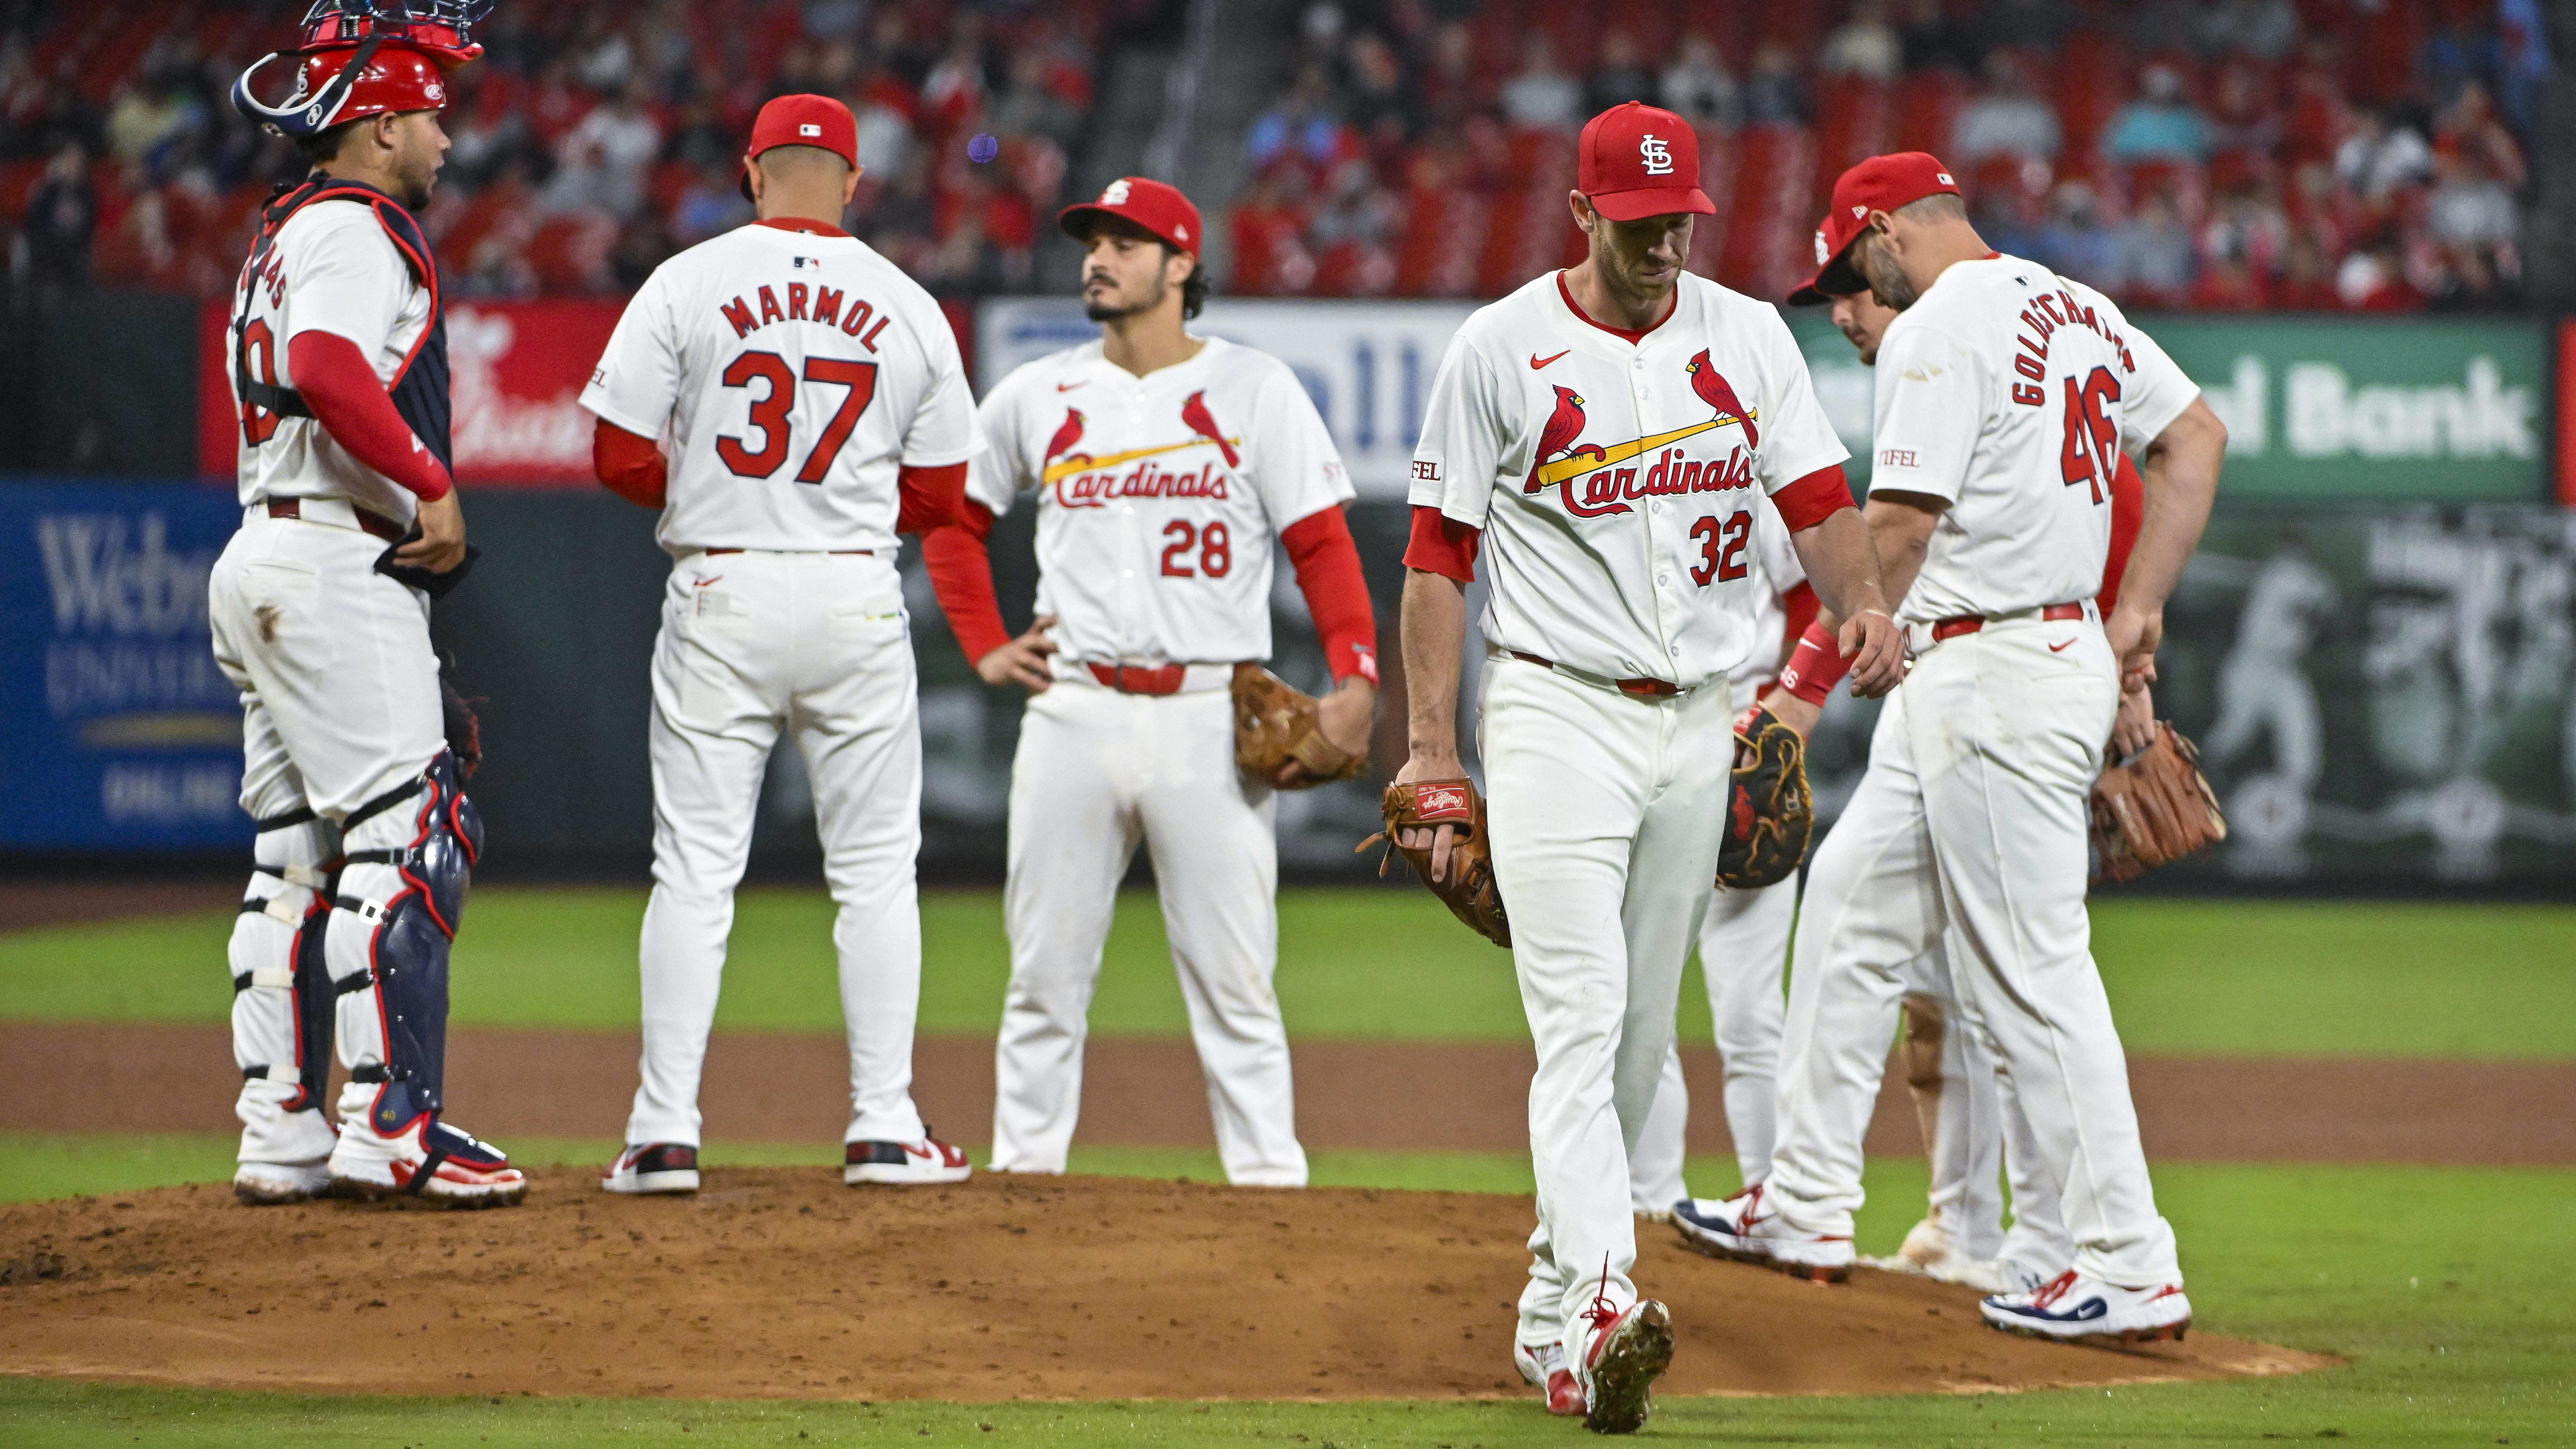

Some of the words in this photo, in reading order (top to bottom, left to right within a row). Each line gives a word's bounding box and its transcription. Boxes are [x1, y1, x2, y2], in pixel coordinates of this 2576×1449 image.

[720, 282, 890, 354] MARMOL
[716, 349, 878, 485] 37
[2061, 365, 2120, 506] 46
[2286, 355, 2541, 460] Bank
[1056, 452, 1228, 508] Cardinals
[1560, 444, 1754, 518] Cardinals
[1161, 520, 1231, 578] 28
[1690, 510, 1753, 588] 32
[1422, 795, 1463, 809] Rawlings
